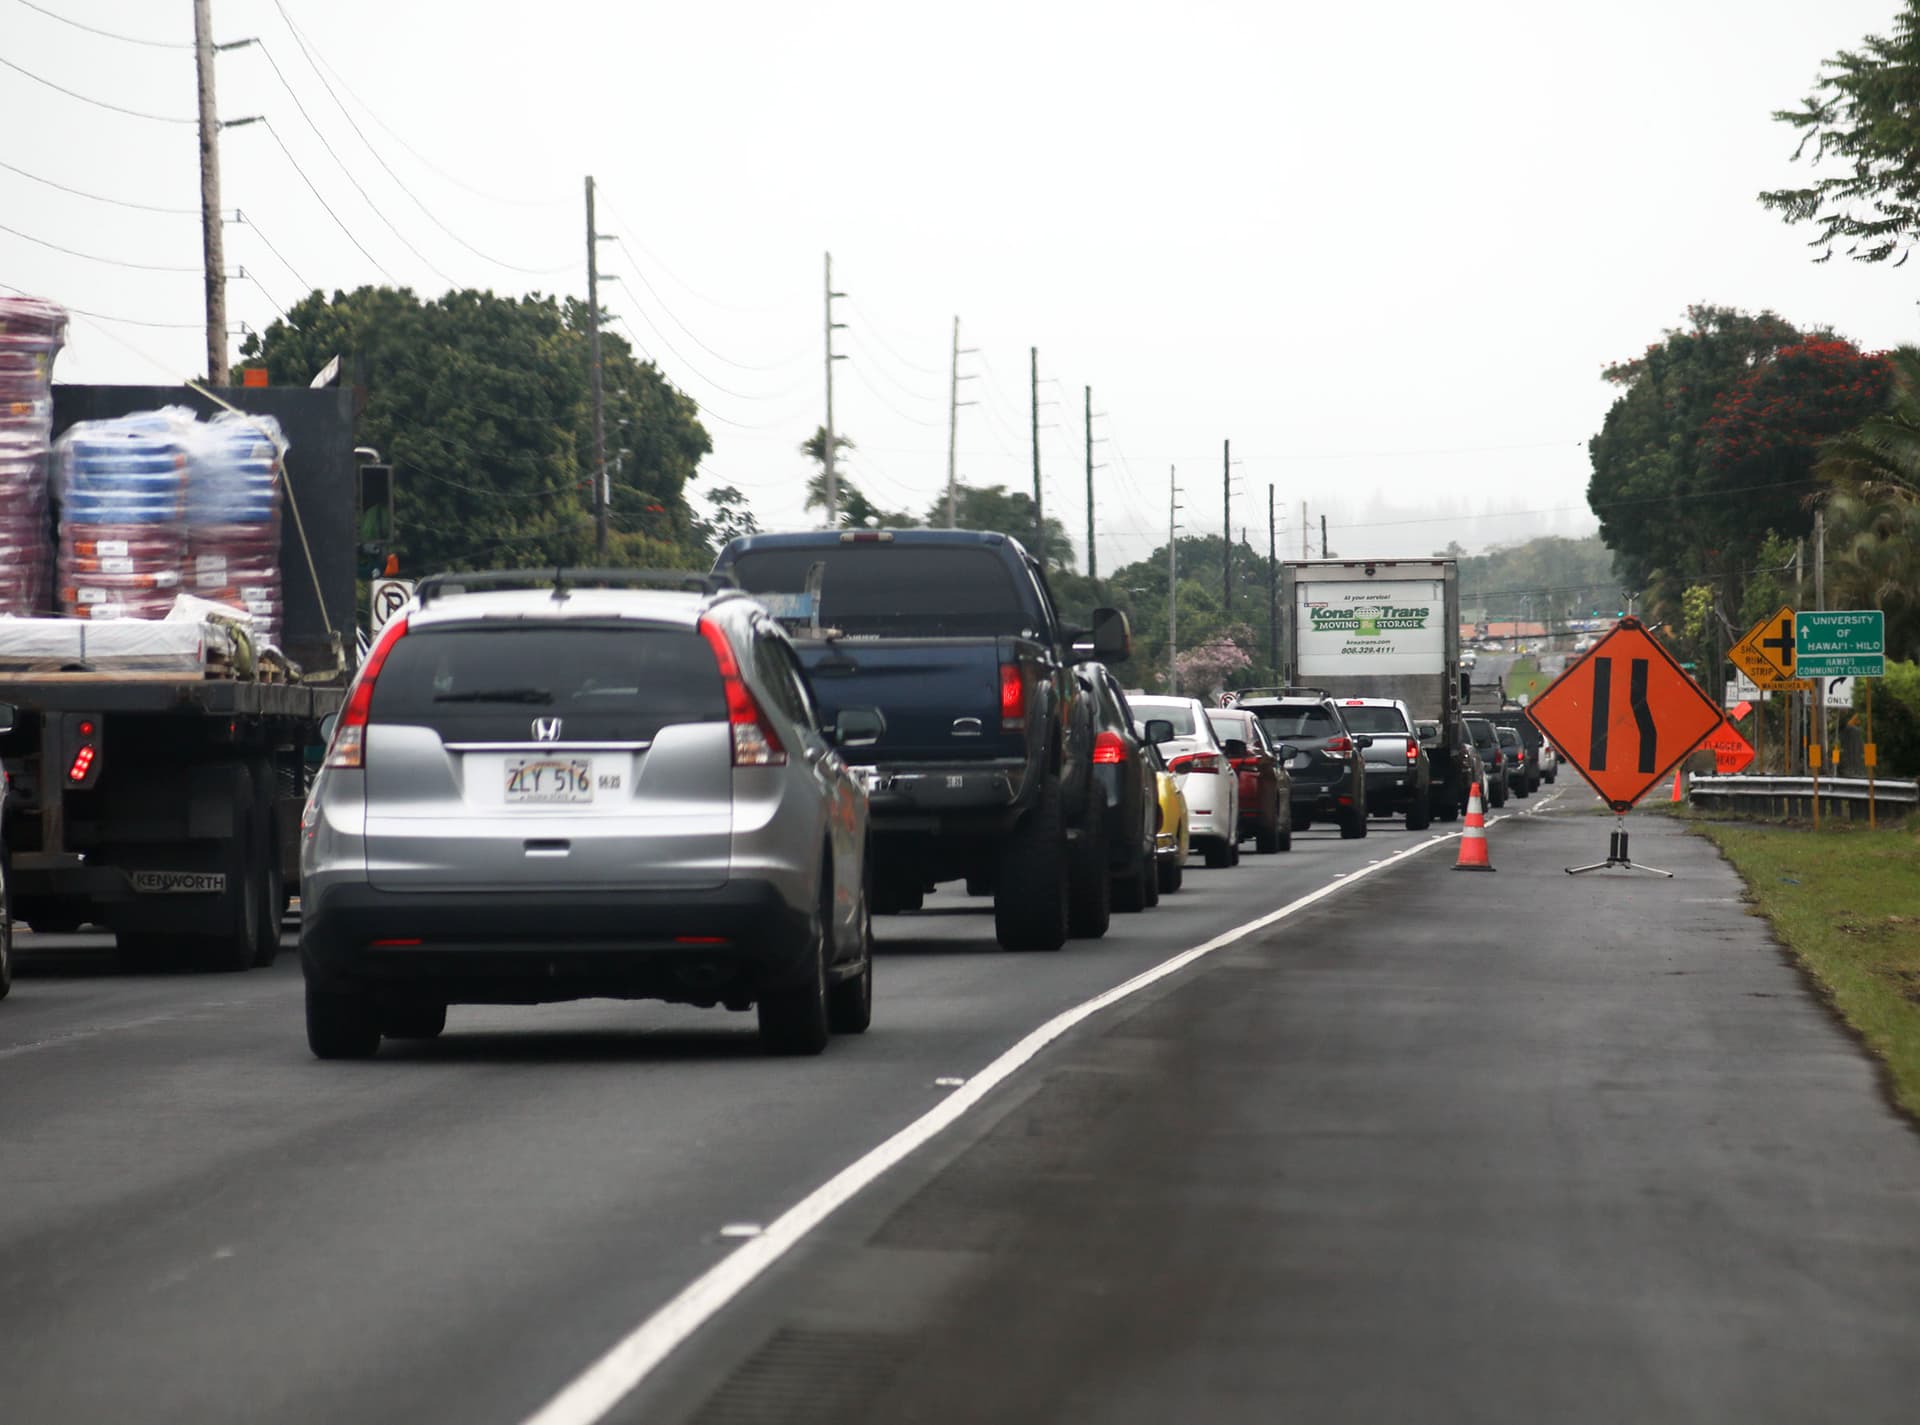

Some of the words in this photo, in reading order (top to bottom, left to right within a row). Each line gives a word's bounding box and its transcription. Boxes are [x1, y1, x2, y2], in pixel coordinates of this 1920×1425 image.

[1310, 607, 1354, 619] Kona
[1381, 606, 1429, 617] Trans
[1319, 621, 1359, 629] MOVING
[1376, 619, 1419, 628] STORAGE
[1812, 616, 1874, 625] UNIVERSITY
[1837, 629, 1851, 638] OF
[1856, 642, 1880, 650] HILO
[1751, 668, 1774, 676] STRIP
[1799, 667, 1844, 676] COMMUNITY
[1847, 666, 1881, 675] COLLEGE
[1704, 741, 1742, 750] FLAGGER
[1716, 756, 1736, 765] HEAD
[508, 768, 542, 792] ZLY
[554, 768, 589, 792] 516
[137, 874, 224, 889] KENWORTH
